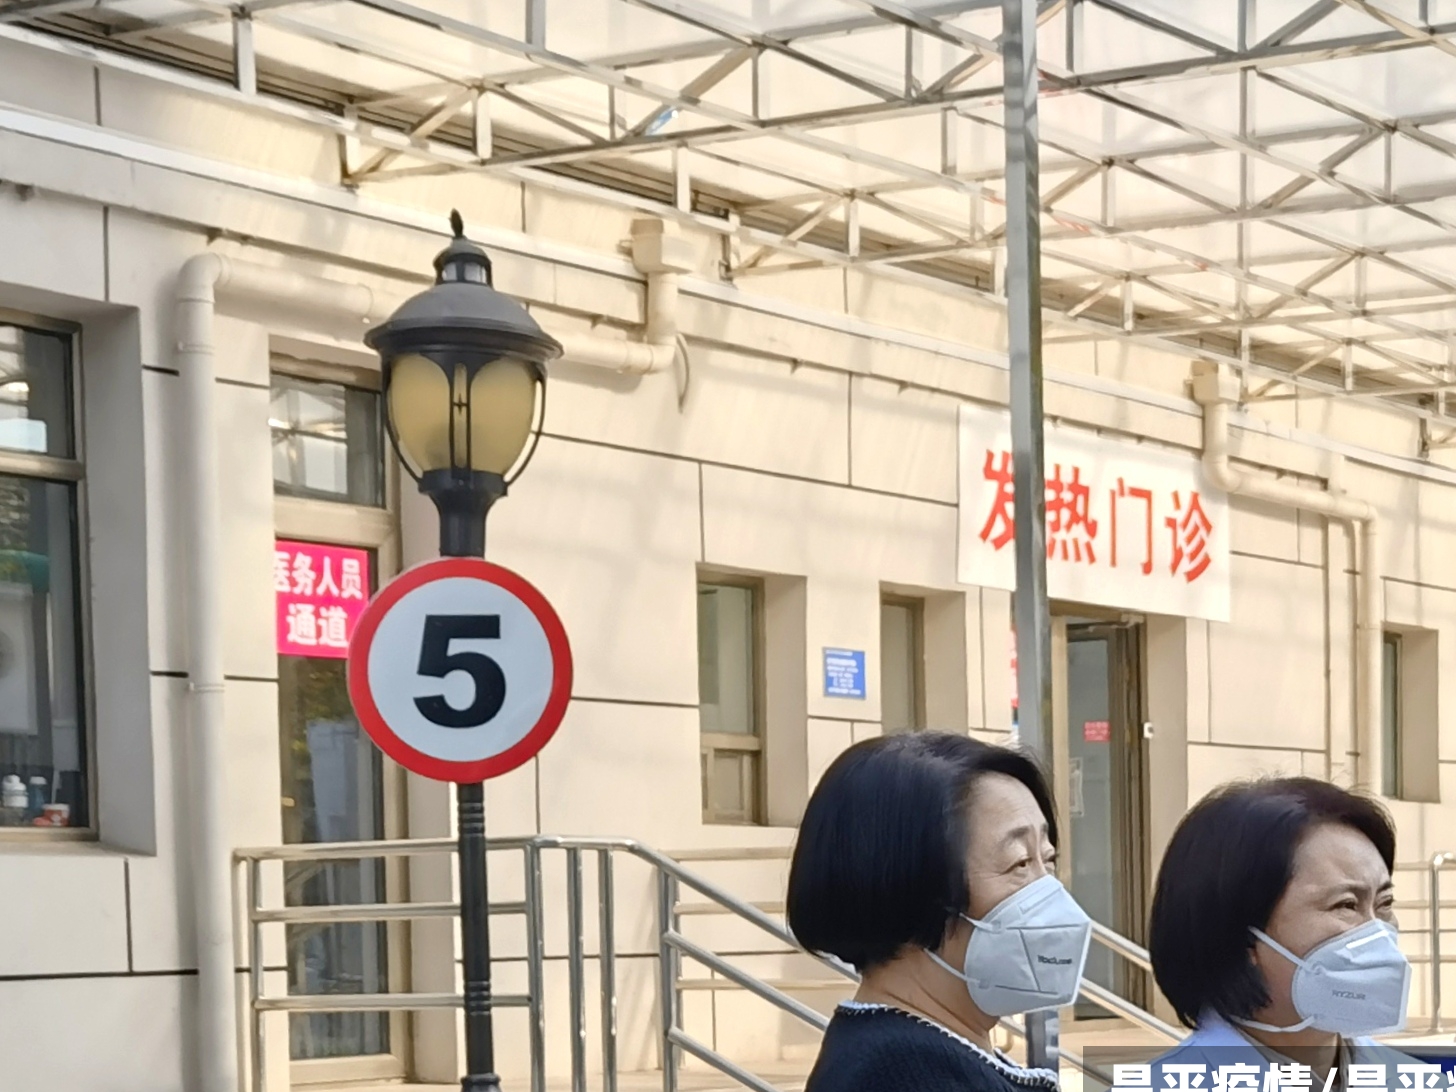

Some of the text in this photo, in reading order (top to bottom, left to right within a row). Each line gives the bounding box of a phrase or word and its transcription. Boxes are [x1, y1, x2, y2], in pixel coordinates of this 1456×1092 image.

[979, 449, 1213, 583] 发热门诊
[274, 551, 363, 600] 医务人员
[286, 603, 349, 648] 通道
[413, 614, 507, 728] 5
